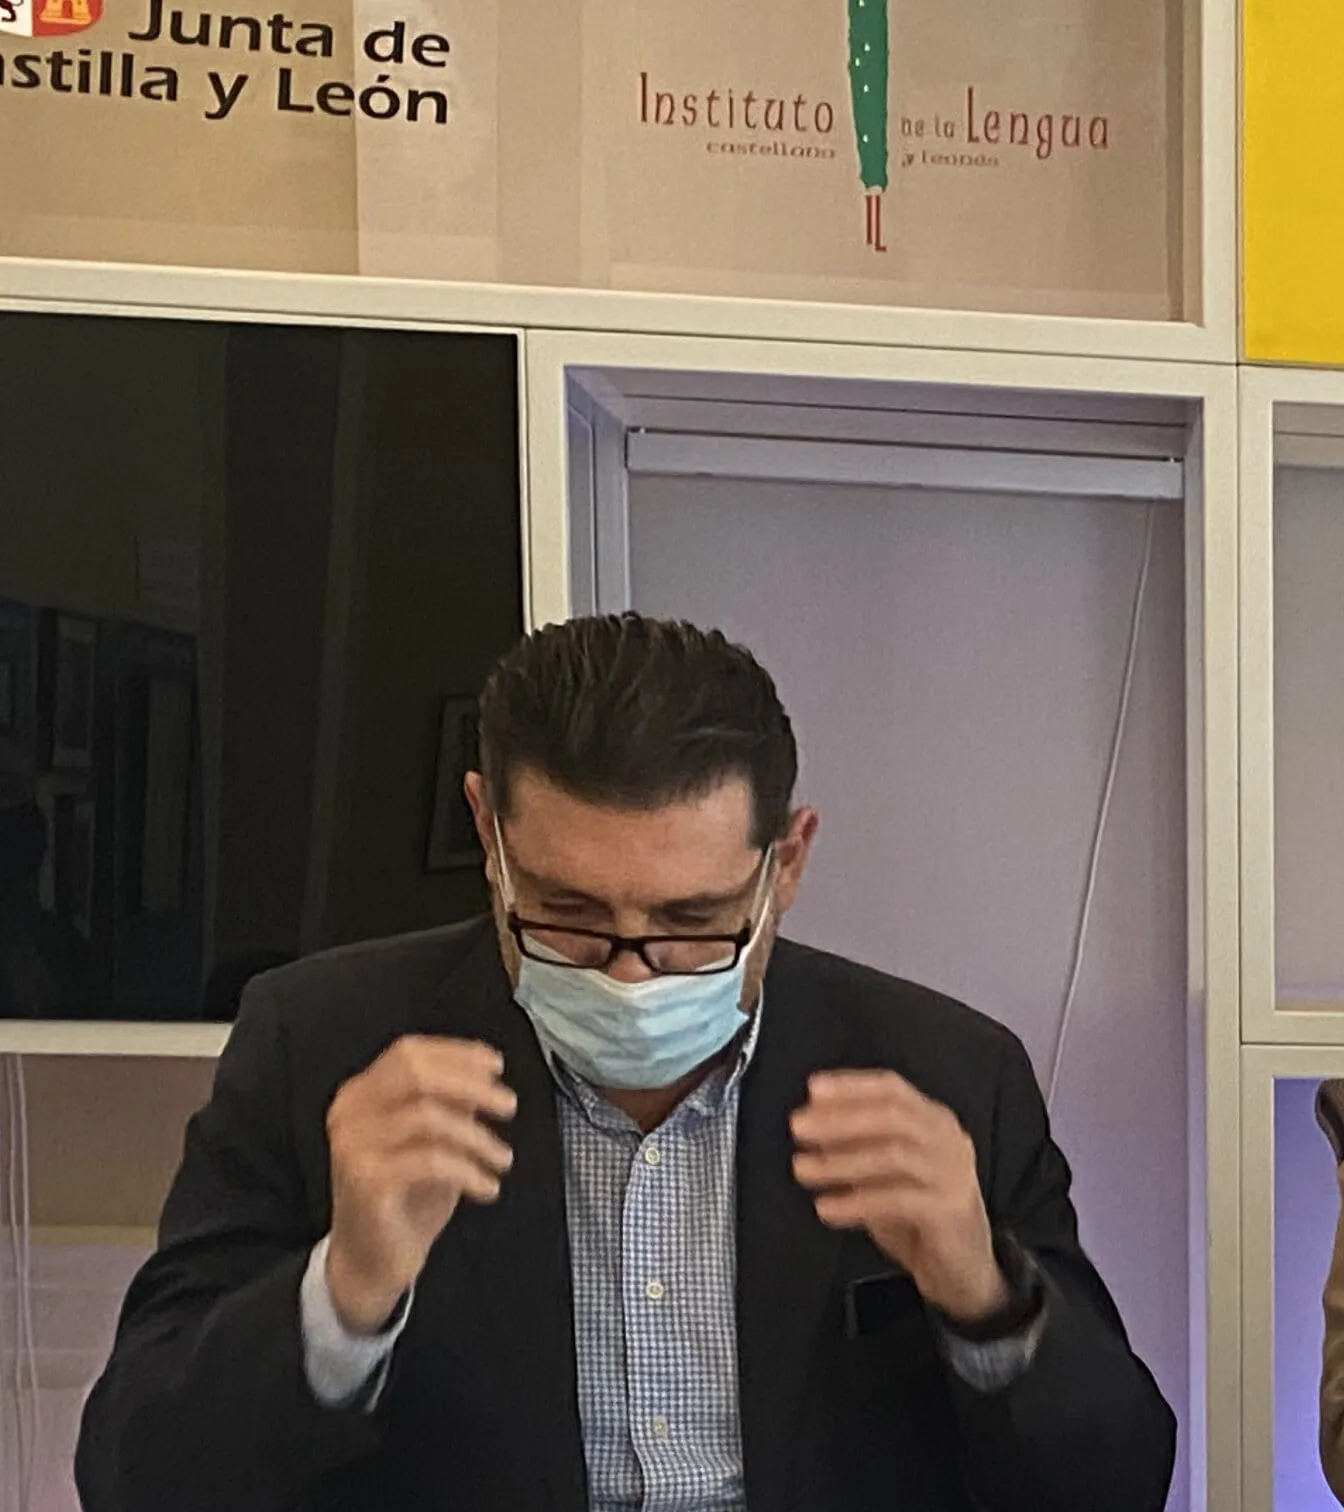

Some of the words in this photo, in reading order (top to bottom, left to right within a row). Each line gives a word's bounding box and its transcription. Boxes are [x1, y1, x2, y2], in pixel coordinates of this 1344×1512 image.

[128, 0, 334, 58] Junta
[363, 21, 450, 67] de
[0, 49, 178, 101] stilla
[205, 71, 249, 120] y
[277, 68, 449, 124] León
[639, 72, 835, 135] Instituto
[935, 114, 955, 139] la
[966, 86, 1110, 160] Lengua
